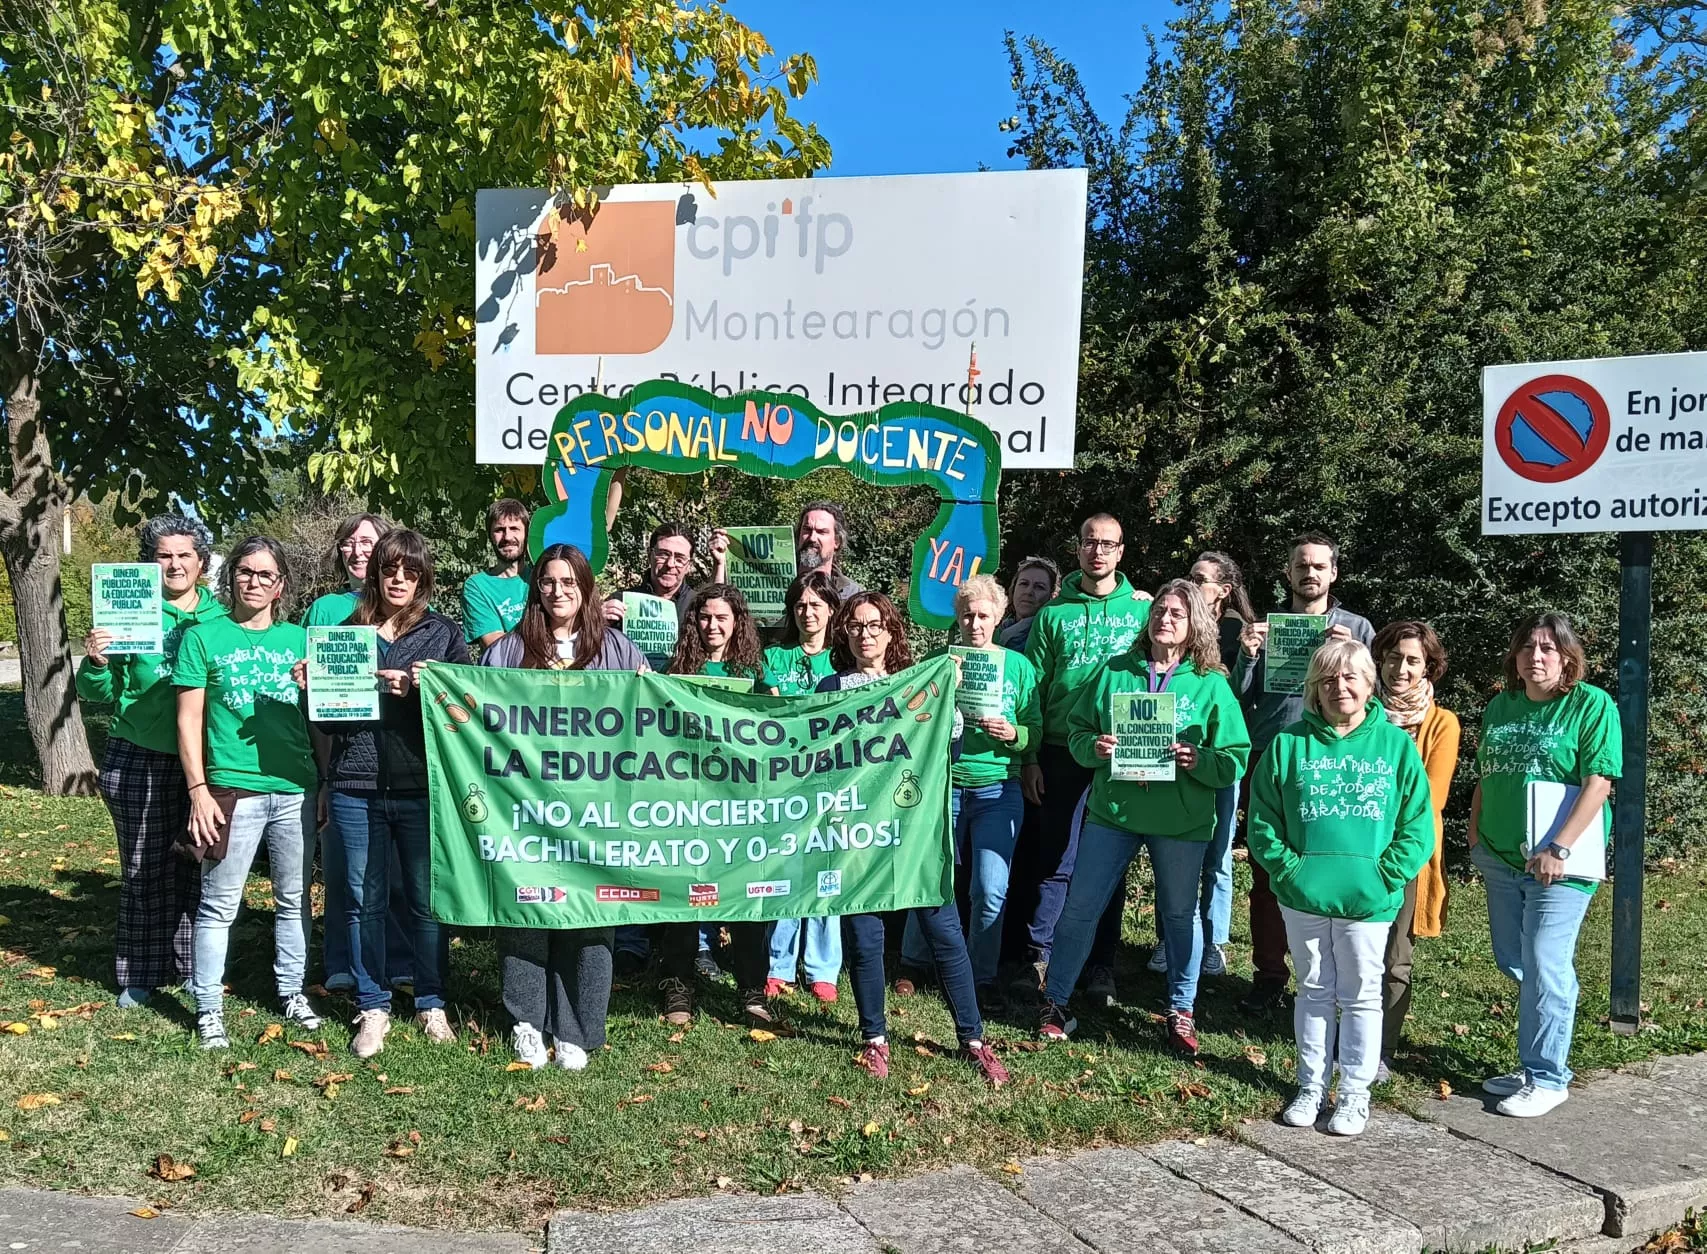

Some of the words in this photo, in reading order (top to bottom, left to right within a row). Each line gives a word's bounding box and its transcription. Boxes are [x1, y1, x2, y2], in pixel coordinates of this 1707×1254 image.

[685, 298, 1010, 350] Montearagón
[1627, 390, 1660, 415] En
[501, 416, 548, 450] de
[1616, 427, 1650, 452] de
[741, 399, 794, 446] NO
[814, 416, 978, 481] DOCENTE
[1488, 496, 1600, 527] Excepto
[741, 534, 774, 560] NO!
[113, 569, 139, 578] DINERO
[730, 561, 741, 574] AL
[743, 562, 793, 575] CONCIERTO
[133, 579, 152, 589] PARA
[102, 590, 111, 600] LA
[640, 600, 662, 618] NO!
[627, 620, 636, 630] AL
[637, 620, 676, 631] CONCIERTO
[328, 632, 355, 641] DINERO
[666, 632, 676, 642] EN
[349, 643, 369, 653] PARA
[317, 654, 326, 664] LA
[966, 652, 989, 662] DINERO
[982, 663, 997, 673] PARA
[230, 675, 249, 687] DE
[1130, 699, 1158, 721] NO!
[482, 703, 624, 737] DINERO
[635, 700, 799, 749] PÚBLICO,
[808, 697, 903, 740] PARA
[1116, 724, 1126, 734] AL
[1127, 723, 1173, 735] CONCIERTO
[1117, 735, 1160, 746] EDUCATIVO
[1114, 747, 1173, 760] BACHILLERATO
[1487, 745, 1502, 755] DE
[484, 746, 531, 779] LA
[540, 747, 758, 784] EDUCACIÓN
[769, 733, 913, 781] PÚBLICA
[1301, 757, 1347, 771] ESCUELA
[1351, 759, 1394, 777] PÚBLICA
[1310, 784, 1329, 796] DE
[512, 800, 572, 831] ¡NO
[578, 801, 620, 829] AL
[627, 795, 810, 829] CONCIERTO
[816, 784, 868, 817] DEL
[1301, 804, 1341, 818] PARA
[478, 834, 710, 868] BACHILLERATO
[716, 837, 741, 865] Y
[746, 832, 799, 863] 0-3
[804, 815, 903, 854] AÑOS!
[748, 886, 765, 894] UGT
